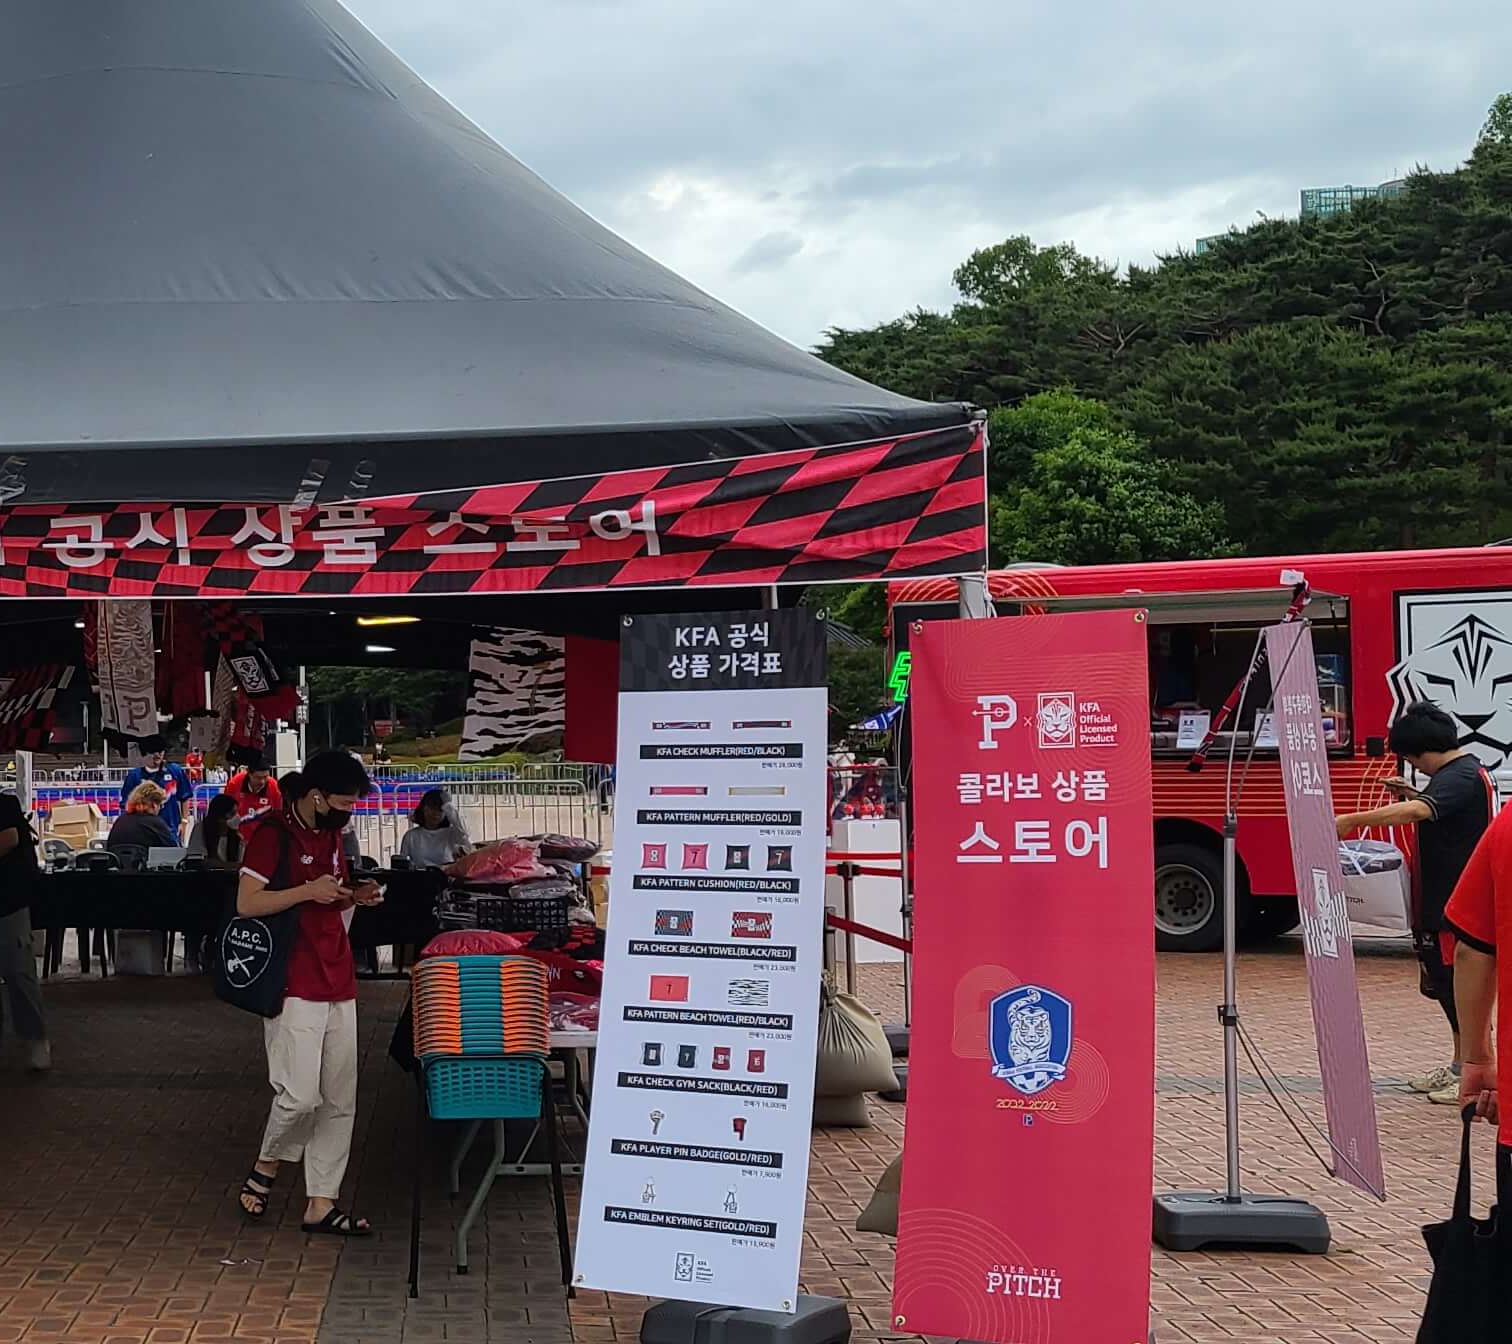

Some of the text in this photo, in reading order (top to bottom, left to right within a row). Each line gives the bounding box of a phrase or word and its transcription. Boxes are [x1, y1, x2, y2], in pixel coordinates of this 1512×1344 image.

[231, 504, 386, 568] 상품
[424, 499, 661, 556] 스토어
[675, 622, 769, 648] KFA 공식
[668, 652, 782, 679] 상품 가격표
[1079, 702, 1101, 712] KFA
[1079, 714, 1112, 723] Official
[1079, 724, 1118, 733] Licensed
[1080, 733, 1115, 743] Product
[657, 746, 785, 756] KFA CHECK MUFFLER(RED/BLACK)
[956, 770, 1110, 805] 콜라보 상품
[646, 813, 791, 823] KFA PATTERN MUFFLER(RED/GOLD)
[956, 816, 1108, 869] 스토어
[641, 878, 791, 890] KFA PATTERN CUSHION(RED/BLACK)
[231, 927, 262, 945] A.P.C.
[633, 944, 791, 958] KFA CHECK BEACH TOWEL(BLACK/RED)
[628, 1009, 788, 1026] KFA PATTERN BEACH TOWEL(RED/BLACK)
[627, 1076, 777, 1095] KFA CHECK GYM SACK(BLACK/RED)
[621, 1143, 772, 1164] KFA PLAYER PIN BADGE(GOLD/RED)
[611, 1210, 770, 1233] KFA EMBLEM KEYRING SET(GOLD/RED)
[993, 1264, 1056, 1277] OVER THE
[986, 1271, 1062, 1299] PITCH
